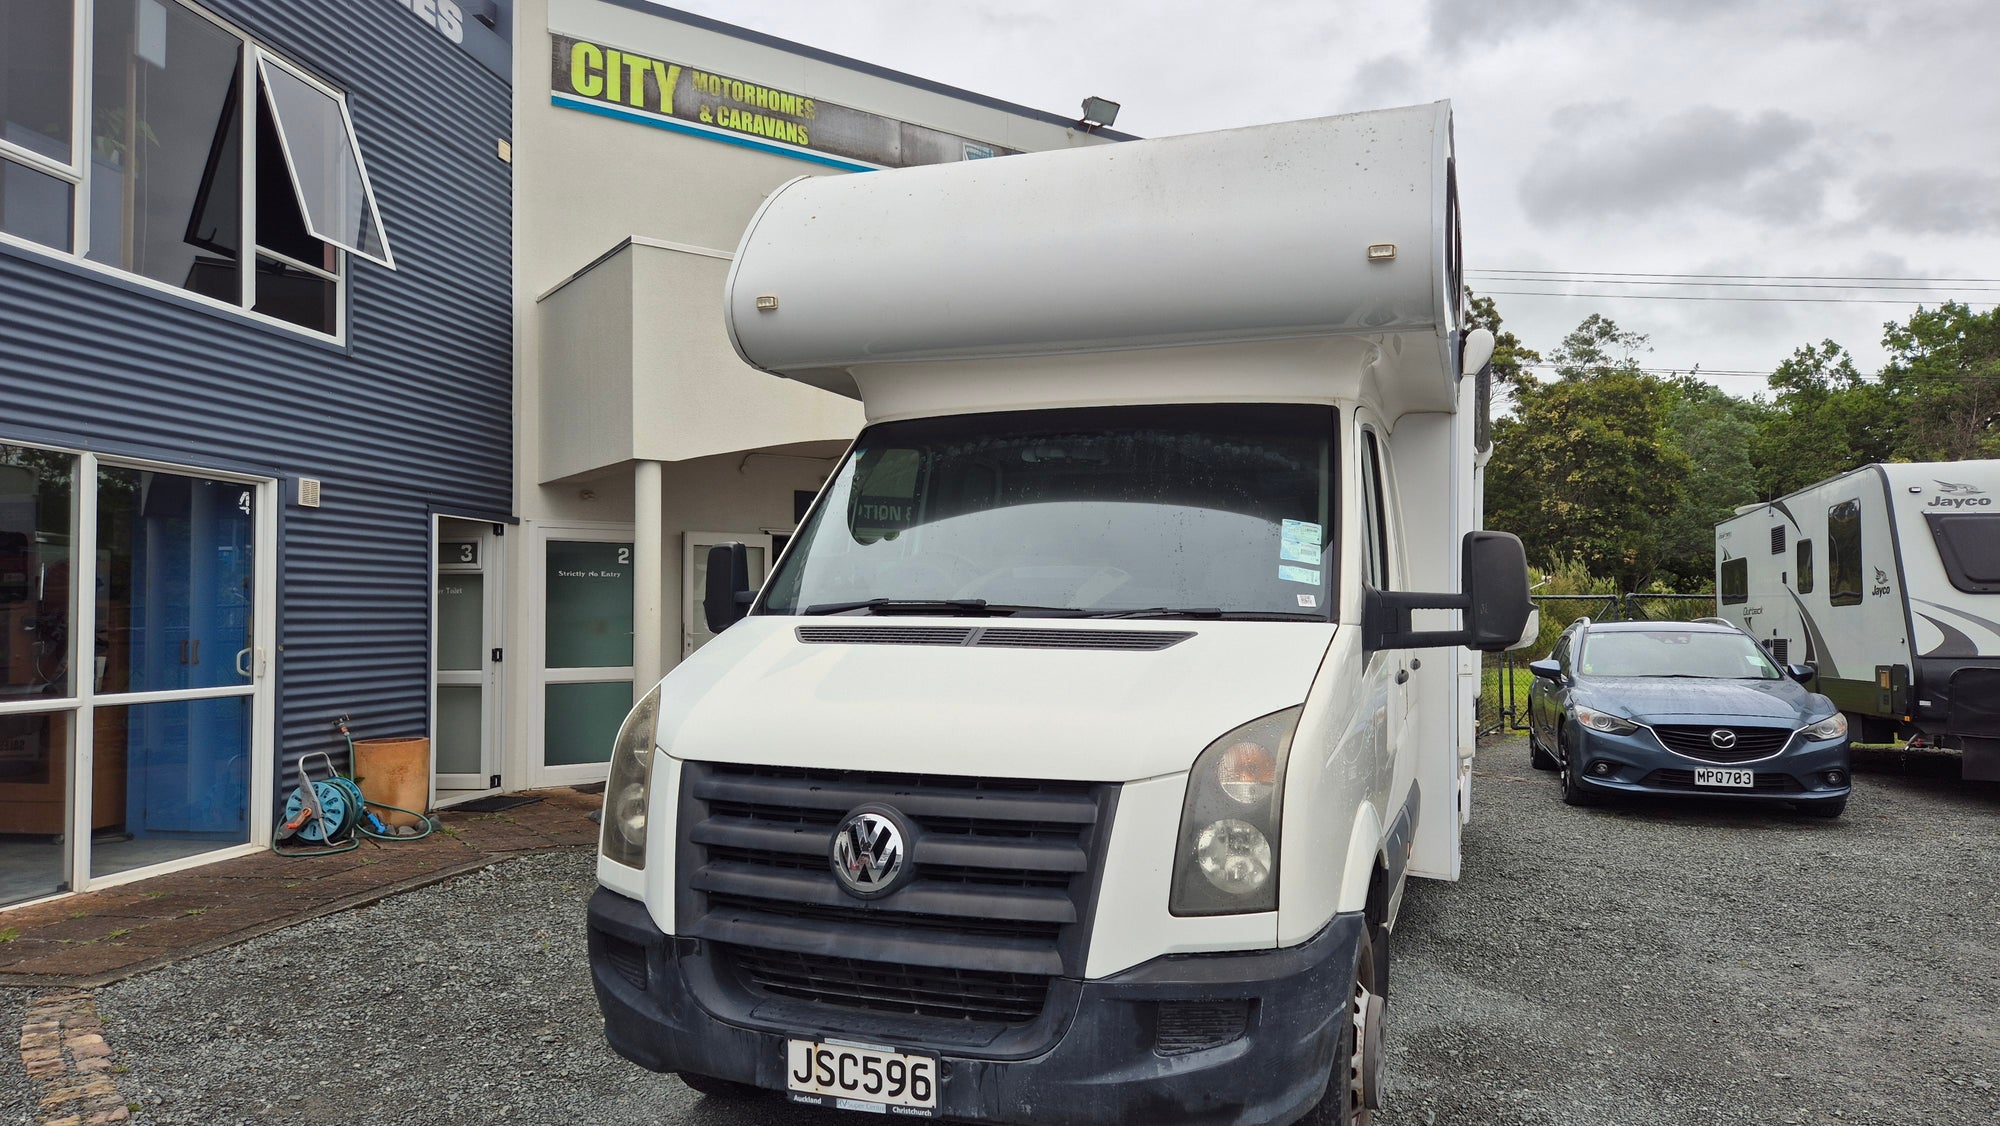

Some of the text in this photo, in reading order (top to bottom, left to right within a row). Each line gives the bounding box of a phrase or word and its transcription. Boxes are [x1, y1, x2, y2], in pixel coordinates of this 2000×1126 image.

[396, 0, 463, 44] ES
[570, 41, 682, 115] CITY
[691, 70, 815, 121] MOTORHOMES
[699, 104, 809, 146] & CARAVANS
[239, 491, 250, 515] 4
[1927, 496, 1992, 508] Jayco
[460, 544, 473, 562] 3
[618, 547, 629, 564] 2
[558, 570, 586, 578] Strictly
[1871, 585, 1890, 598] Jayco
[1697, 770, 1752, 785] MPQ703
[793, 1047, 931, 1102] JSC596
[793, 1095, 822, 1105] Auckland
[892, 1106, 932, 1117] Christchurch
